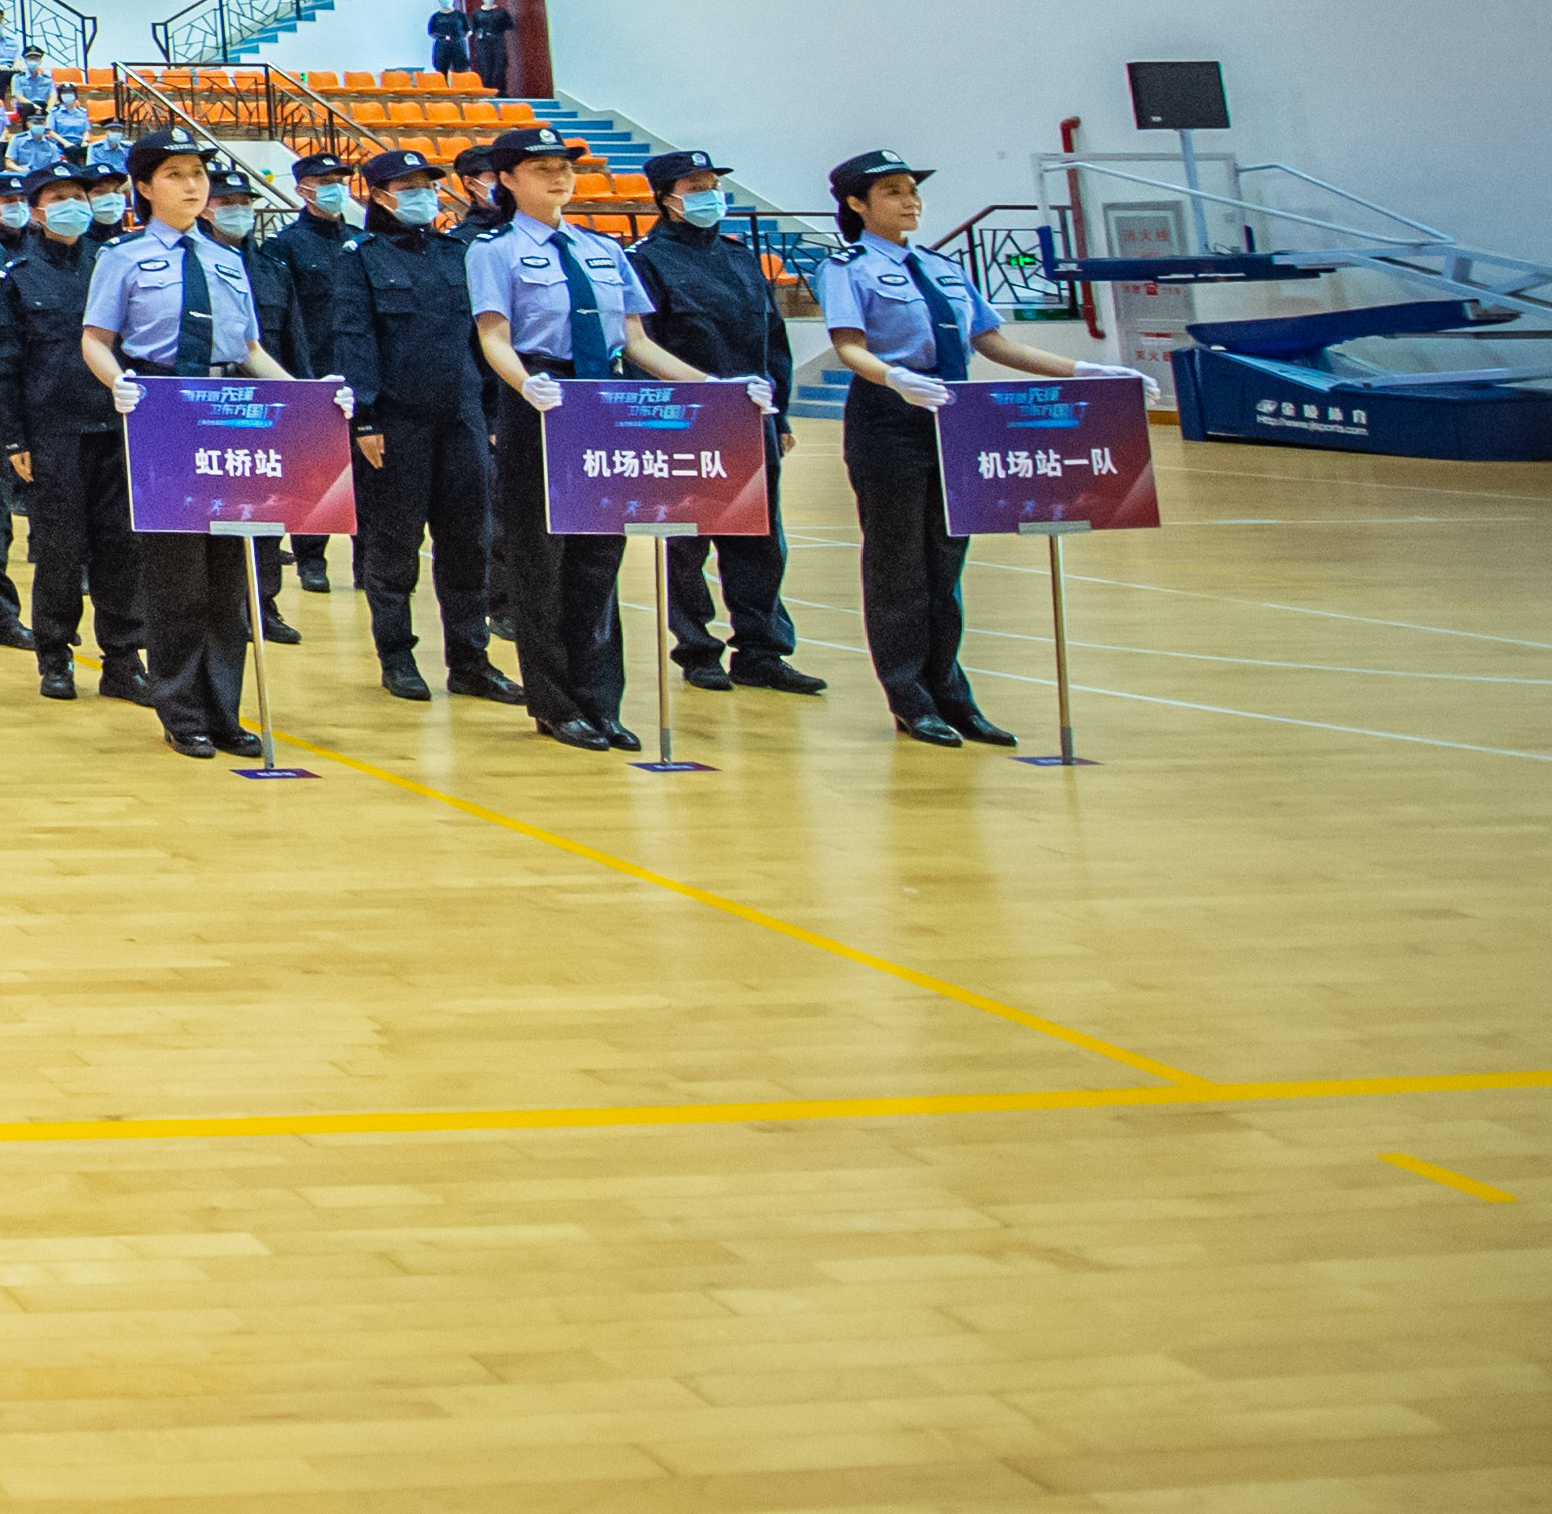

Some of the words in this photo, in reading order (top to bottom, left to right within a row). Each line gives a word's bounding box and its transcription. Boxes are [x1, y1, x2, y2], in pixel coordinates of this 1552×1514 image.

[195, 448, 283, 477] 虹桥站
[583, 449, 727, 479] 机场站二队
[978, 448, 1118, 479] 机场站一队
